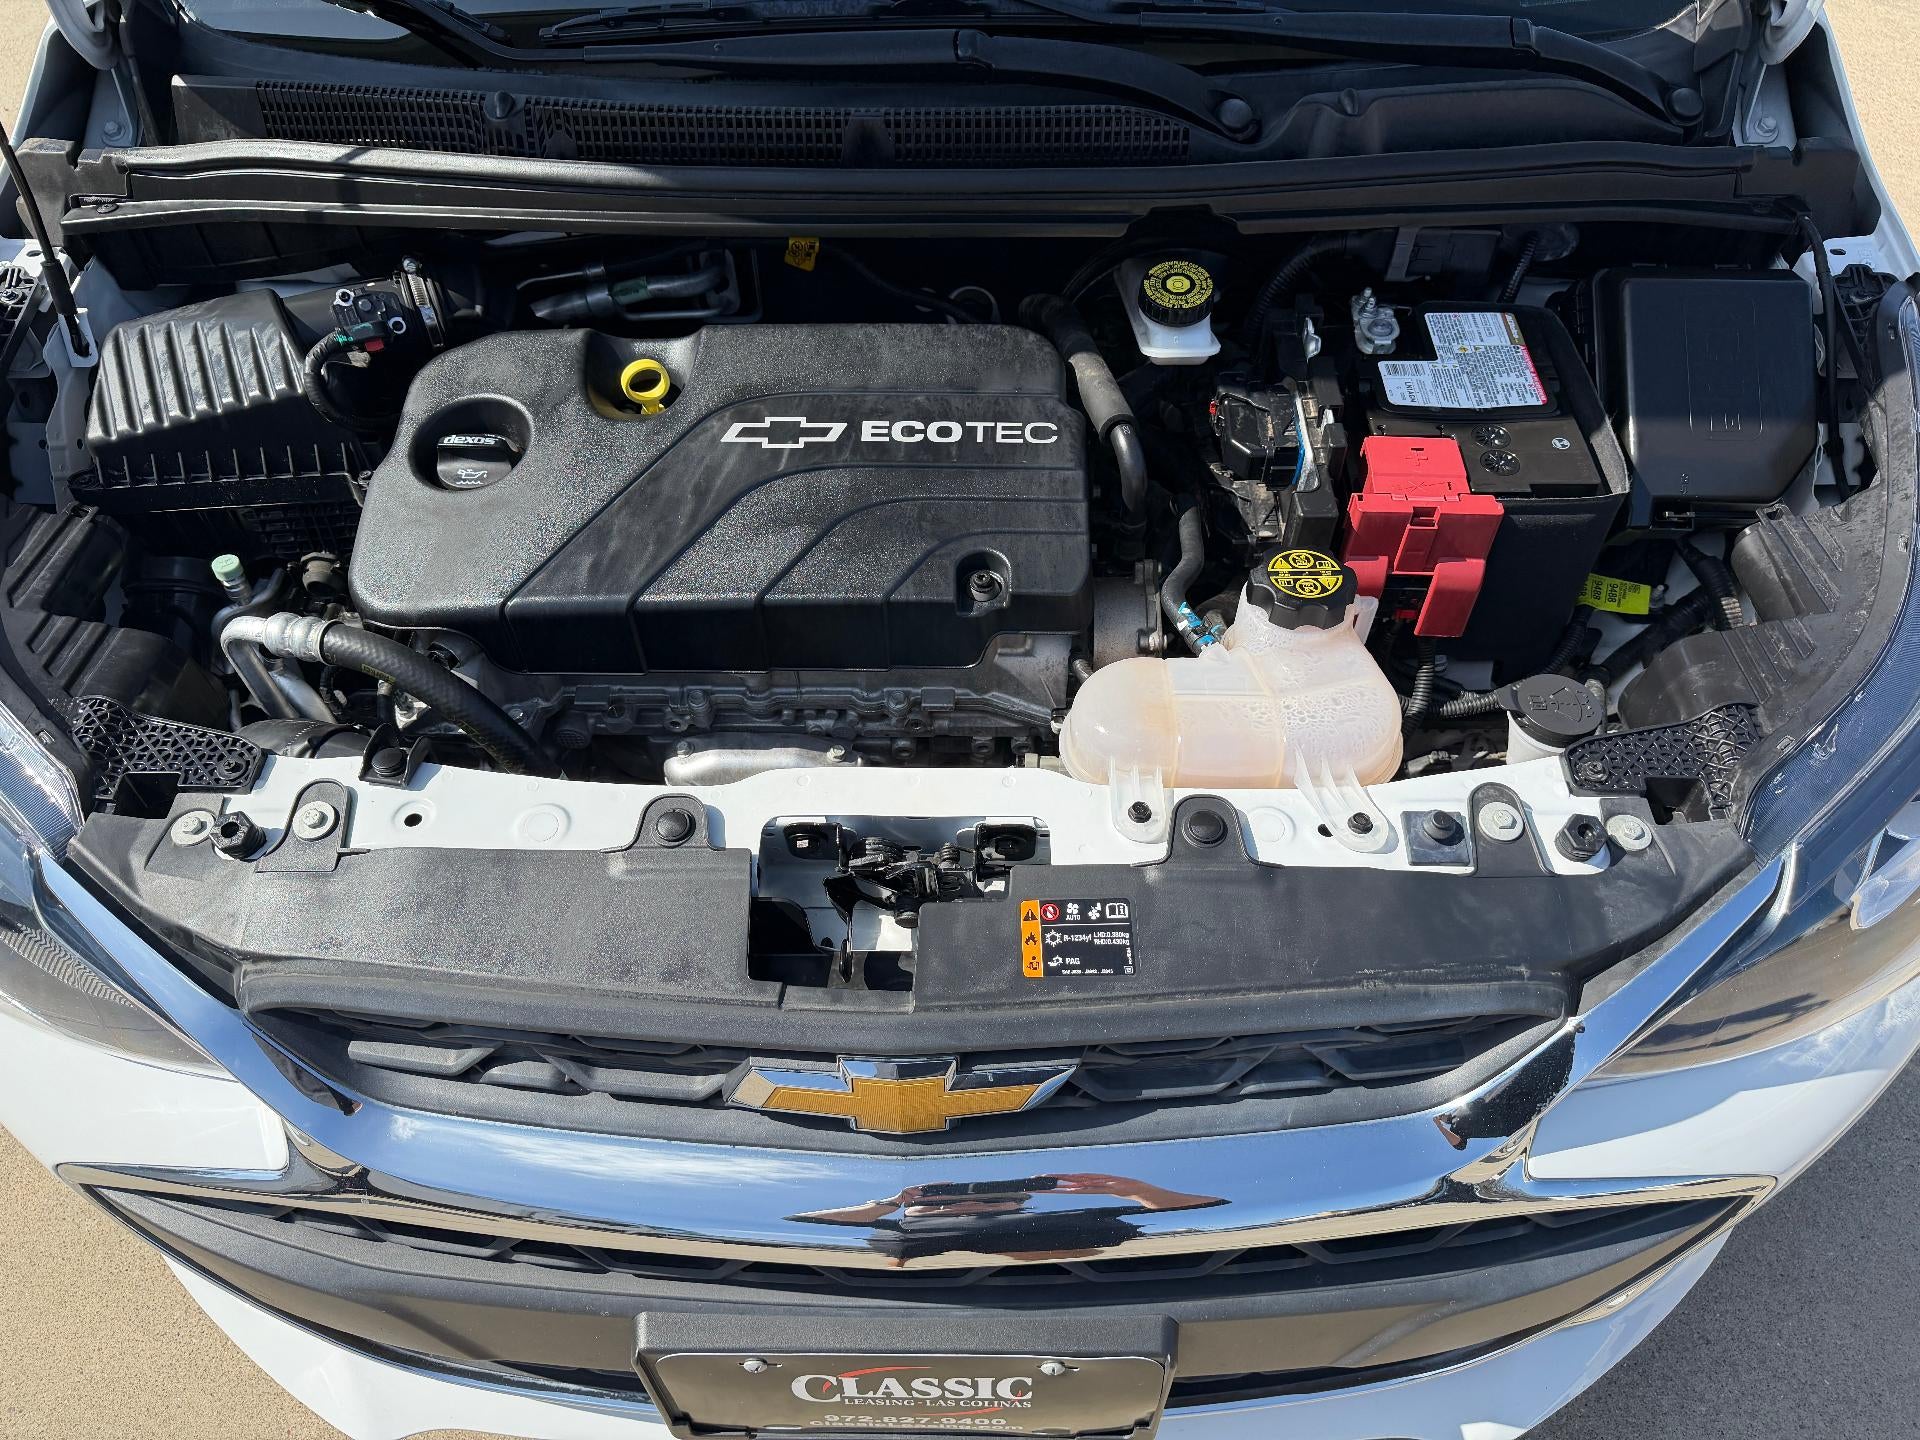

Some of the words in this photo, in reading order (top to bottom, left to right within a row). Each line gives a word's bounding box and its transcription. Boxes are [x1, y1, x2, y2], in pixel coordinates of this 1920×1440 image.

[443, 434, 497, 445] dexos
[861, 420, 1058, 444] ECOTEC
[1607, 583, 1619, 603] 9488
[1065, 957, 1081, 965] PAG
[791, 1374, 1033, 1403] CLASSIC
[844, 1398, 914, 1406] LEASING
[926, 1399, 956, 1407] LAS
[959, 1399, 1032, 1409] COLINAS
